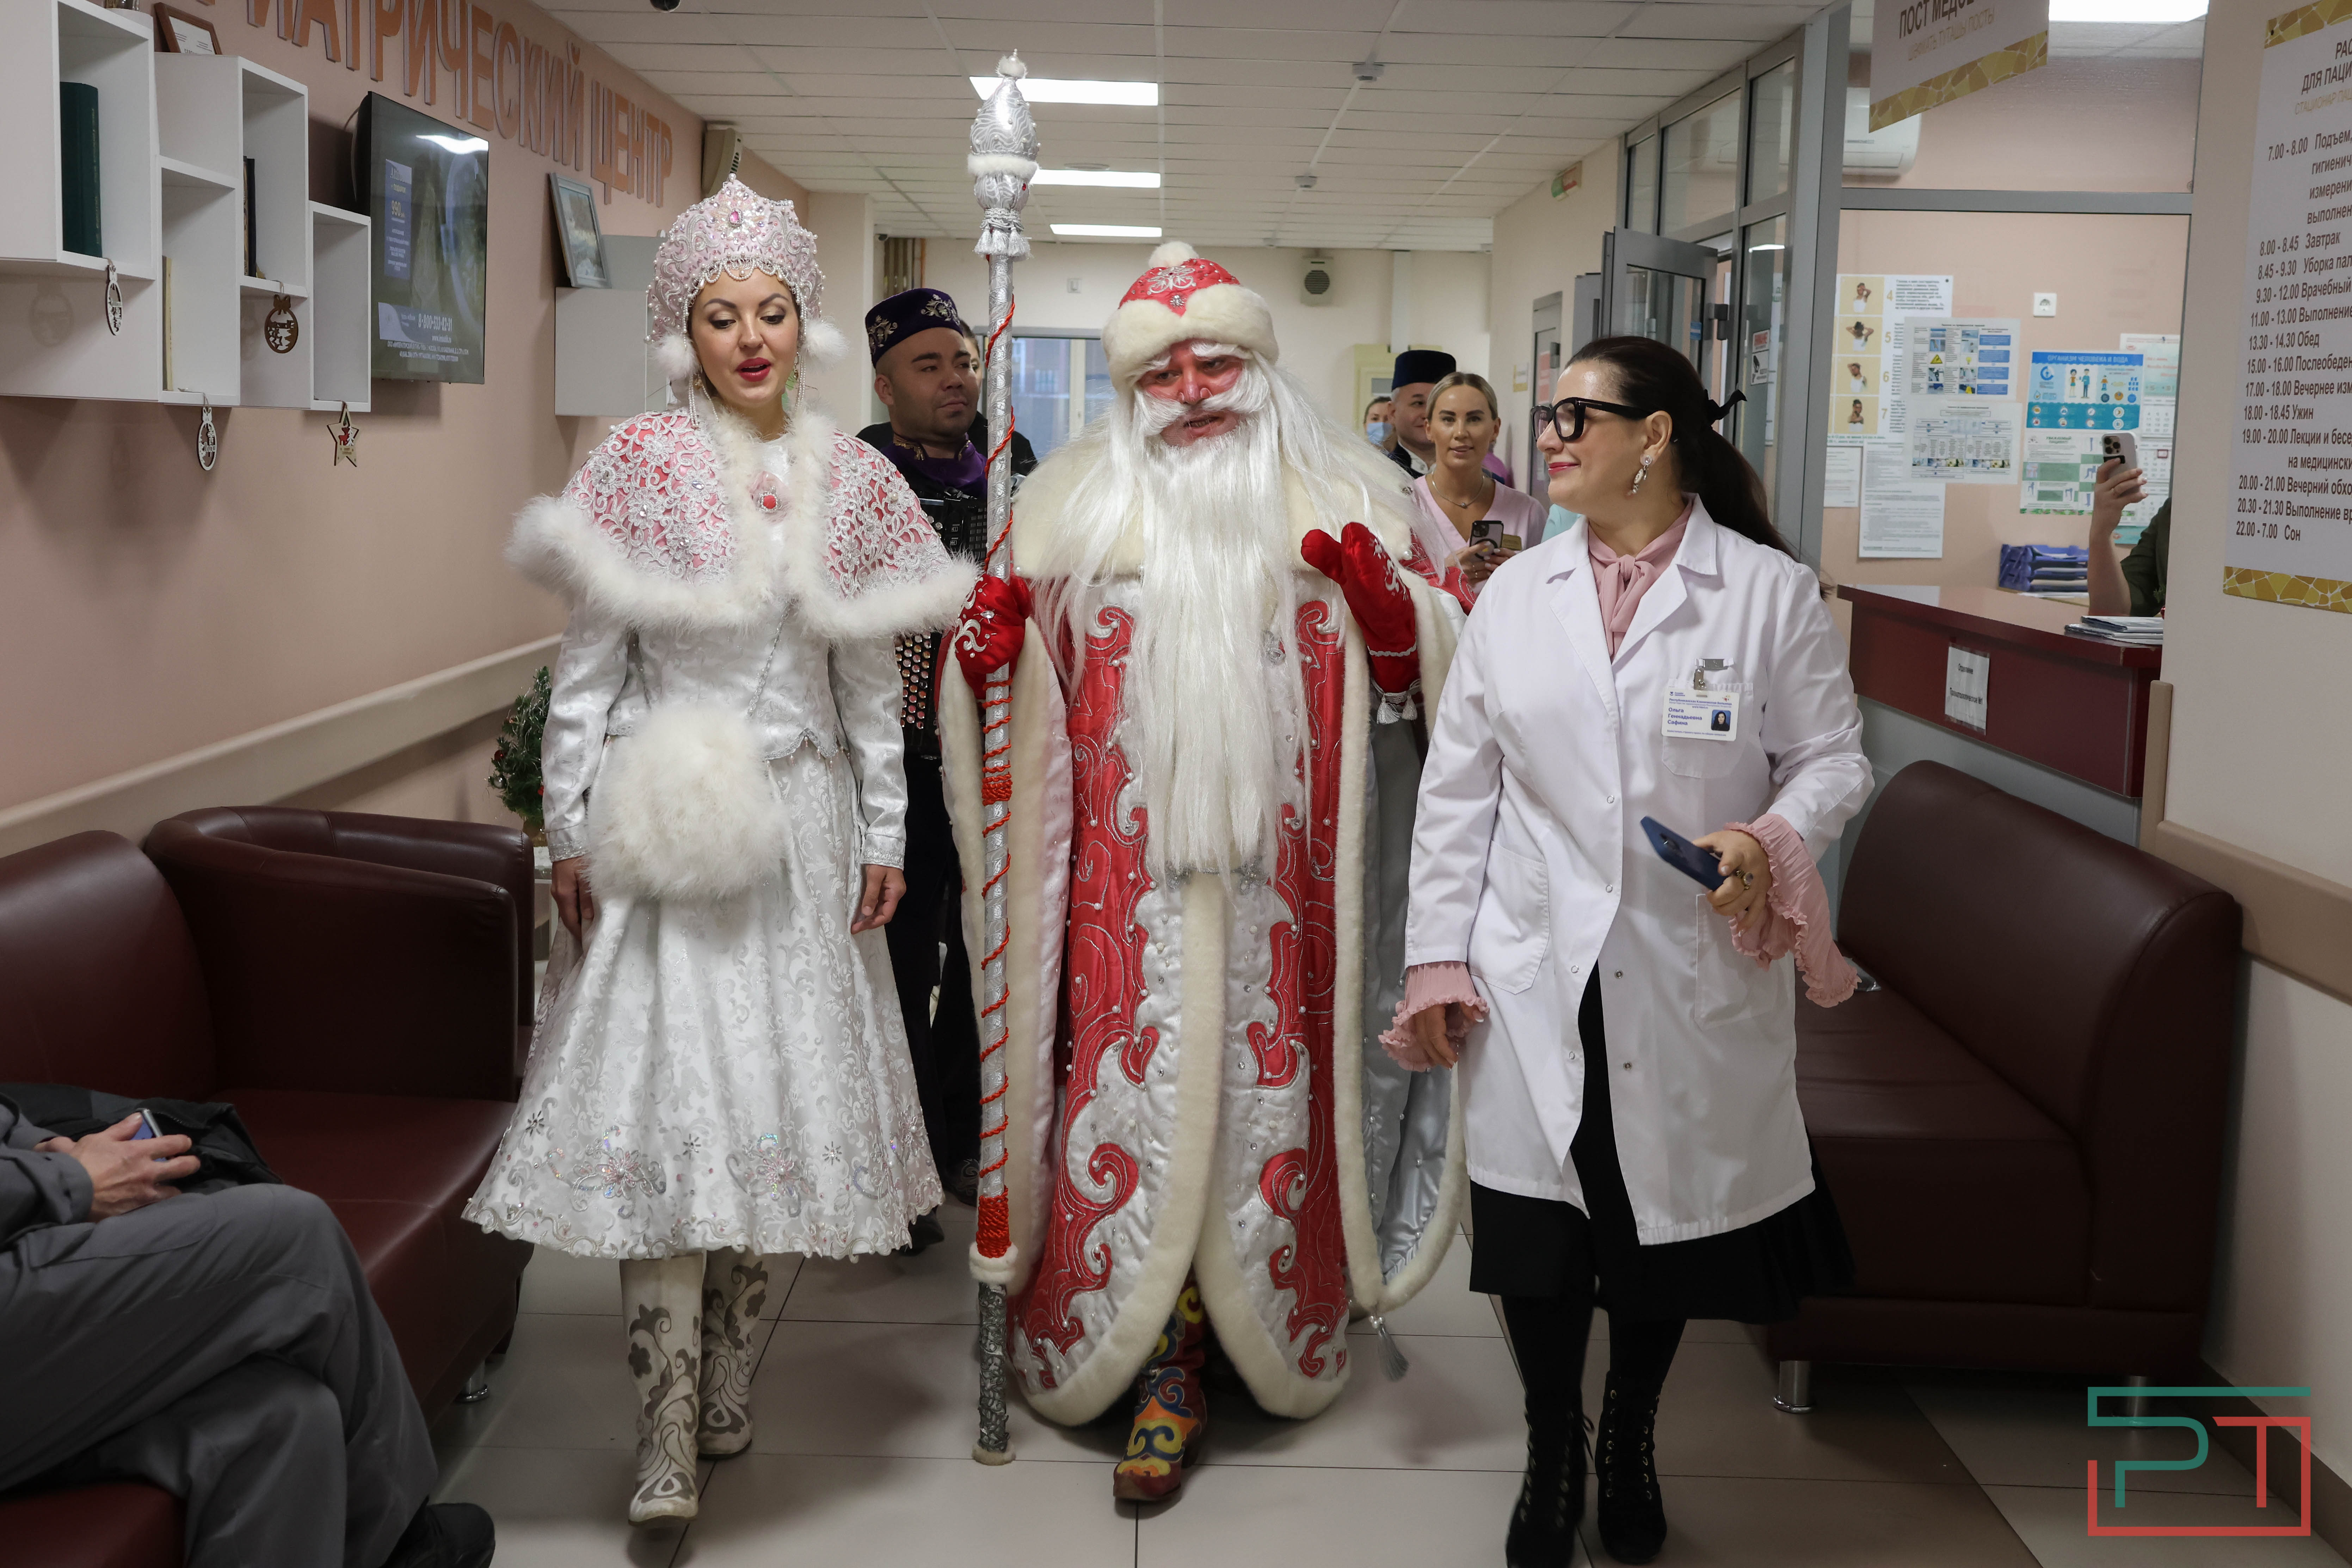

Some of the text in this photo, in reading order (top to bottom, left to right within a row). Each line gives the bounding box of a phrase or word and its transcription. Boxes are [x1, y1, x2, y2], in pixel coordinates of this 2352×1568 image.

[1900, 0, 1974, 39] ПОСТ МЕД
[2301, 61, 2352, 95] ДЛЯ ПАЦИ
[591, 78, 673, 208] ЦЕНТР
[2268, 143, 2284, 161] 7.00
[2291, 137, 2308, 155] 8.00
[392, 200, 401, 216] 990
[2260, 239, 2276, 256] 8.00
[2282, 235, 2299, 253] 8.45
[2305, 232, 2341, 250] Завтрак
[2258, 263, 2274, 280] 8.45
[2280, 259, 2297, 277] 9.30
[2303, 257, 2334, 275] Уборка
[1886, 290, 1893, 301] 4
[2256, 287, 2272, 303] 9.30
[2279, 283, 2299, 300] 12.00
[2301, 276, 2352, 301] Врачебный
[2251, 310, 2269, 327] 11.00
[2277, 307, 2297, 325] 13.00
[2299, 306, 2352, 322] Выполнение
[1885, 331, 1891, 343] 5
[2249, 334, 2268, 350] 13.30
[2275, 332, 2295, 349] 14.30
[2298, 330, 2320, 348] Обед
[2248, 358, 2266, 374] 15.00
[2273, 356, 2293, 373] 16.00
[2296, 353, 2352, 372] Послеобеден
[1883, 371, 1889, 382] 6
[2246, 381, 2264, 397] 17.00
[2272, 380, 2292, 396] 18.00
[2294, 380, 2334, 399] Вечернее
[1881, 408, 1887, 419] 7
[2244, 405, 2263, 420] 18.00
[2270, 404, 2290, 420] 18.45
[2292, 404, 2314, 420] Ужин
[2242, 428, 2261, 443] 19.00
[2267, 428, 2288, 444] 20.00
[2290, 428, 2321, 447] Лекции
[2323, 432, 2329, 444] и
[2331, 428, 2352, 447] бесе
[2288, 456, 2298, 468] на
[2239, 475, 2258, 490] 20.00
[2265, 475, 2285, 492] 21.00
[2287, 476, 2329, 497] Вечерний
[2331, 478, 2352, 498] обхо
[2237, 498, 2256, 514] 20.30
[2263, 499, 2284, 516] 21.30
[2286, 500, 2341, 520] Выполнение
[2236, 521, 2255, 537] 22.00
[2262, 523, 2277, 539] 7.00
[2285, 524, 2301, 541] Сон
